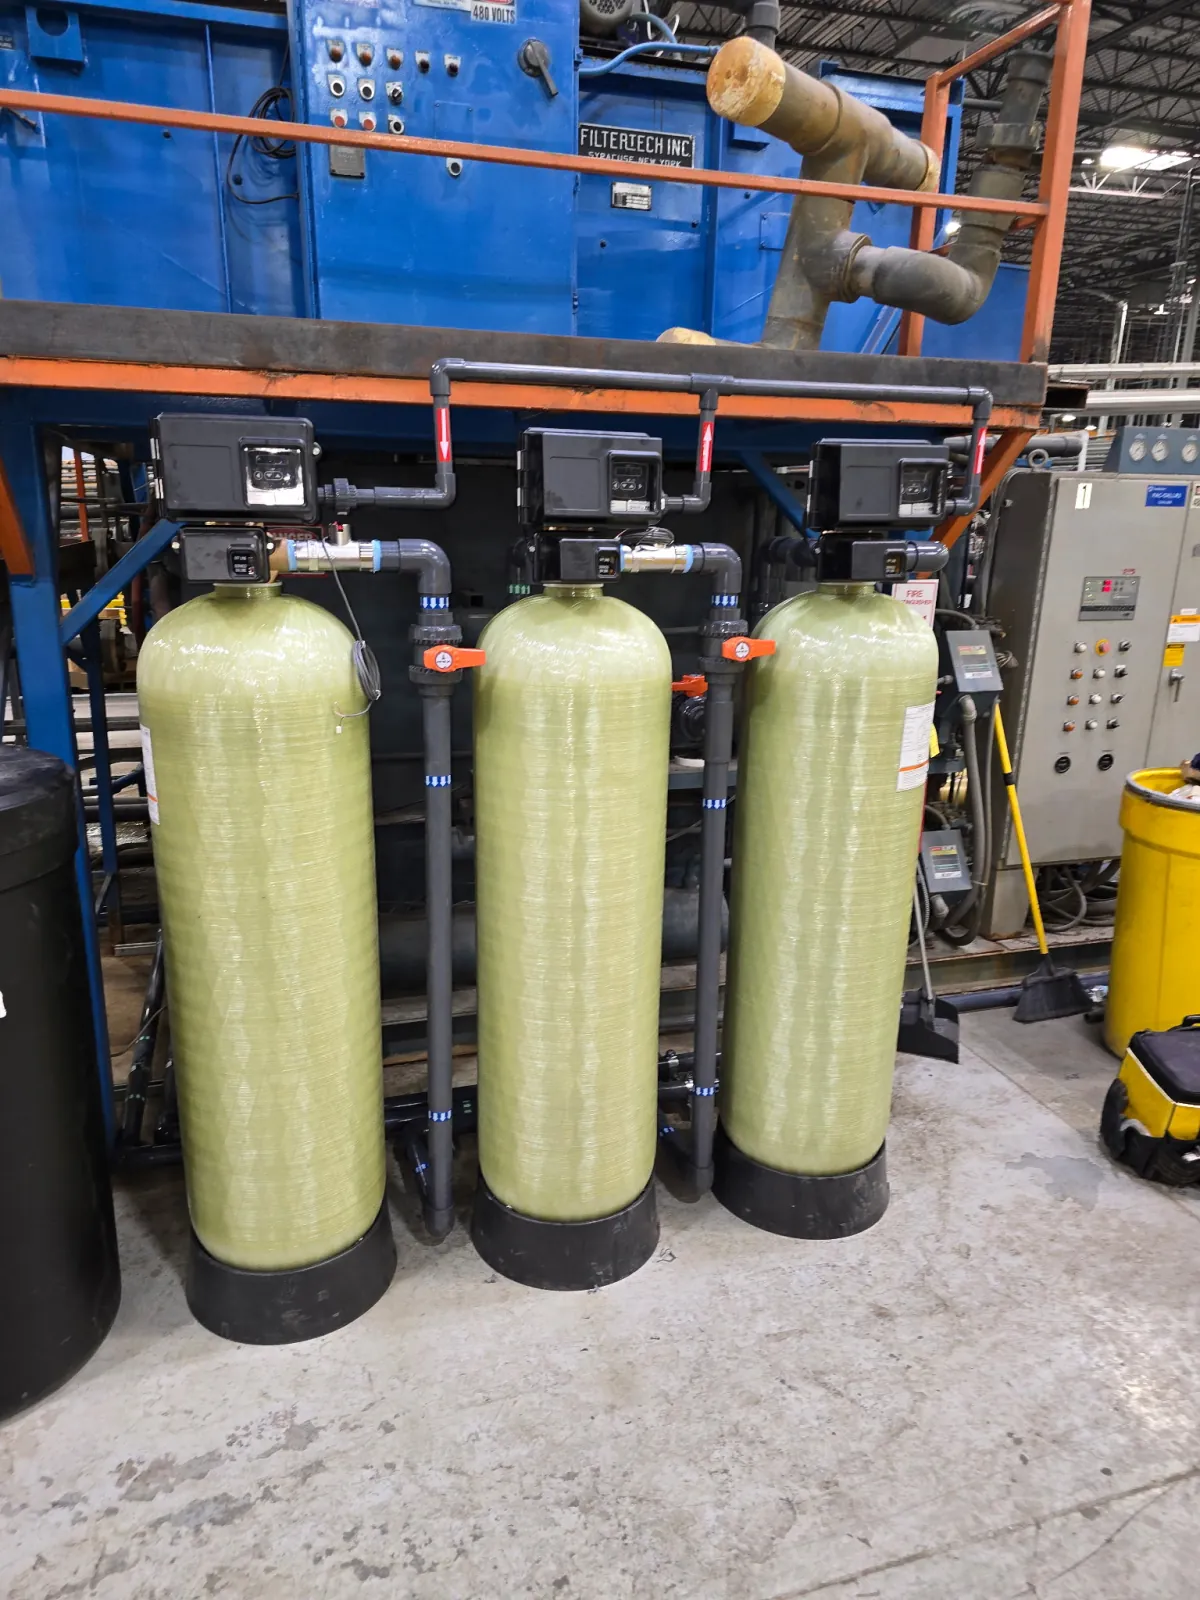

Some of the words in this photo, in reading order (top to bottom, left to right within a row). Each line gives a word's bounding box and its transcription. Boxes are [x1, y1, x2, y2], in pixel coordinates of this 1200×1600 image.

[473, 4, 490, 21] 480
[491, 7, 516, 25] VOLTS
[580, 128, 664, 155] FILTERTECH
[588, 151, 635, 163] SYRACUSE
[638, 156, 657, 166] NEW
[659, 159, 682, 168] YORK
[906, 590, 924, 598] FIRE
